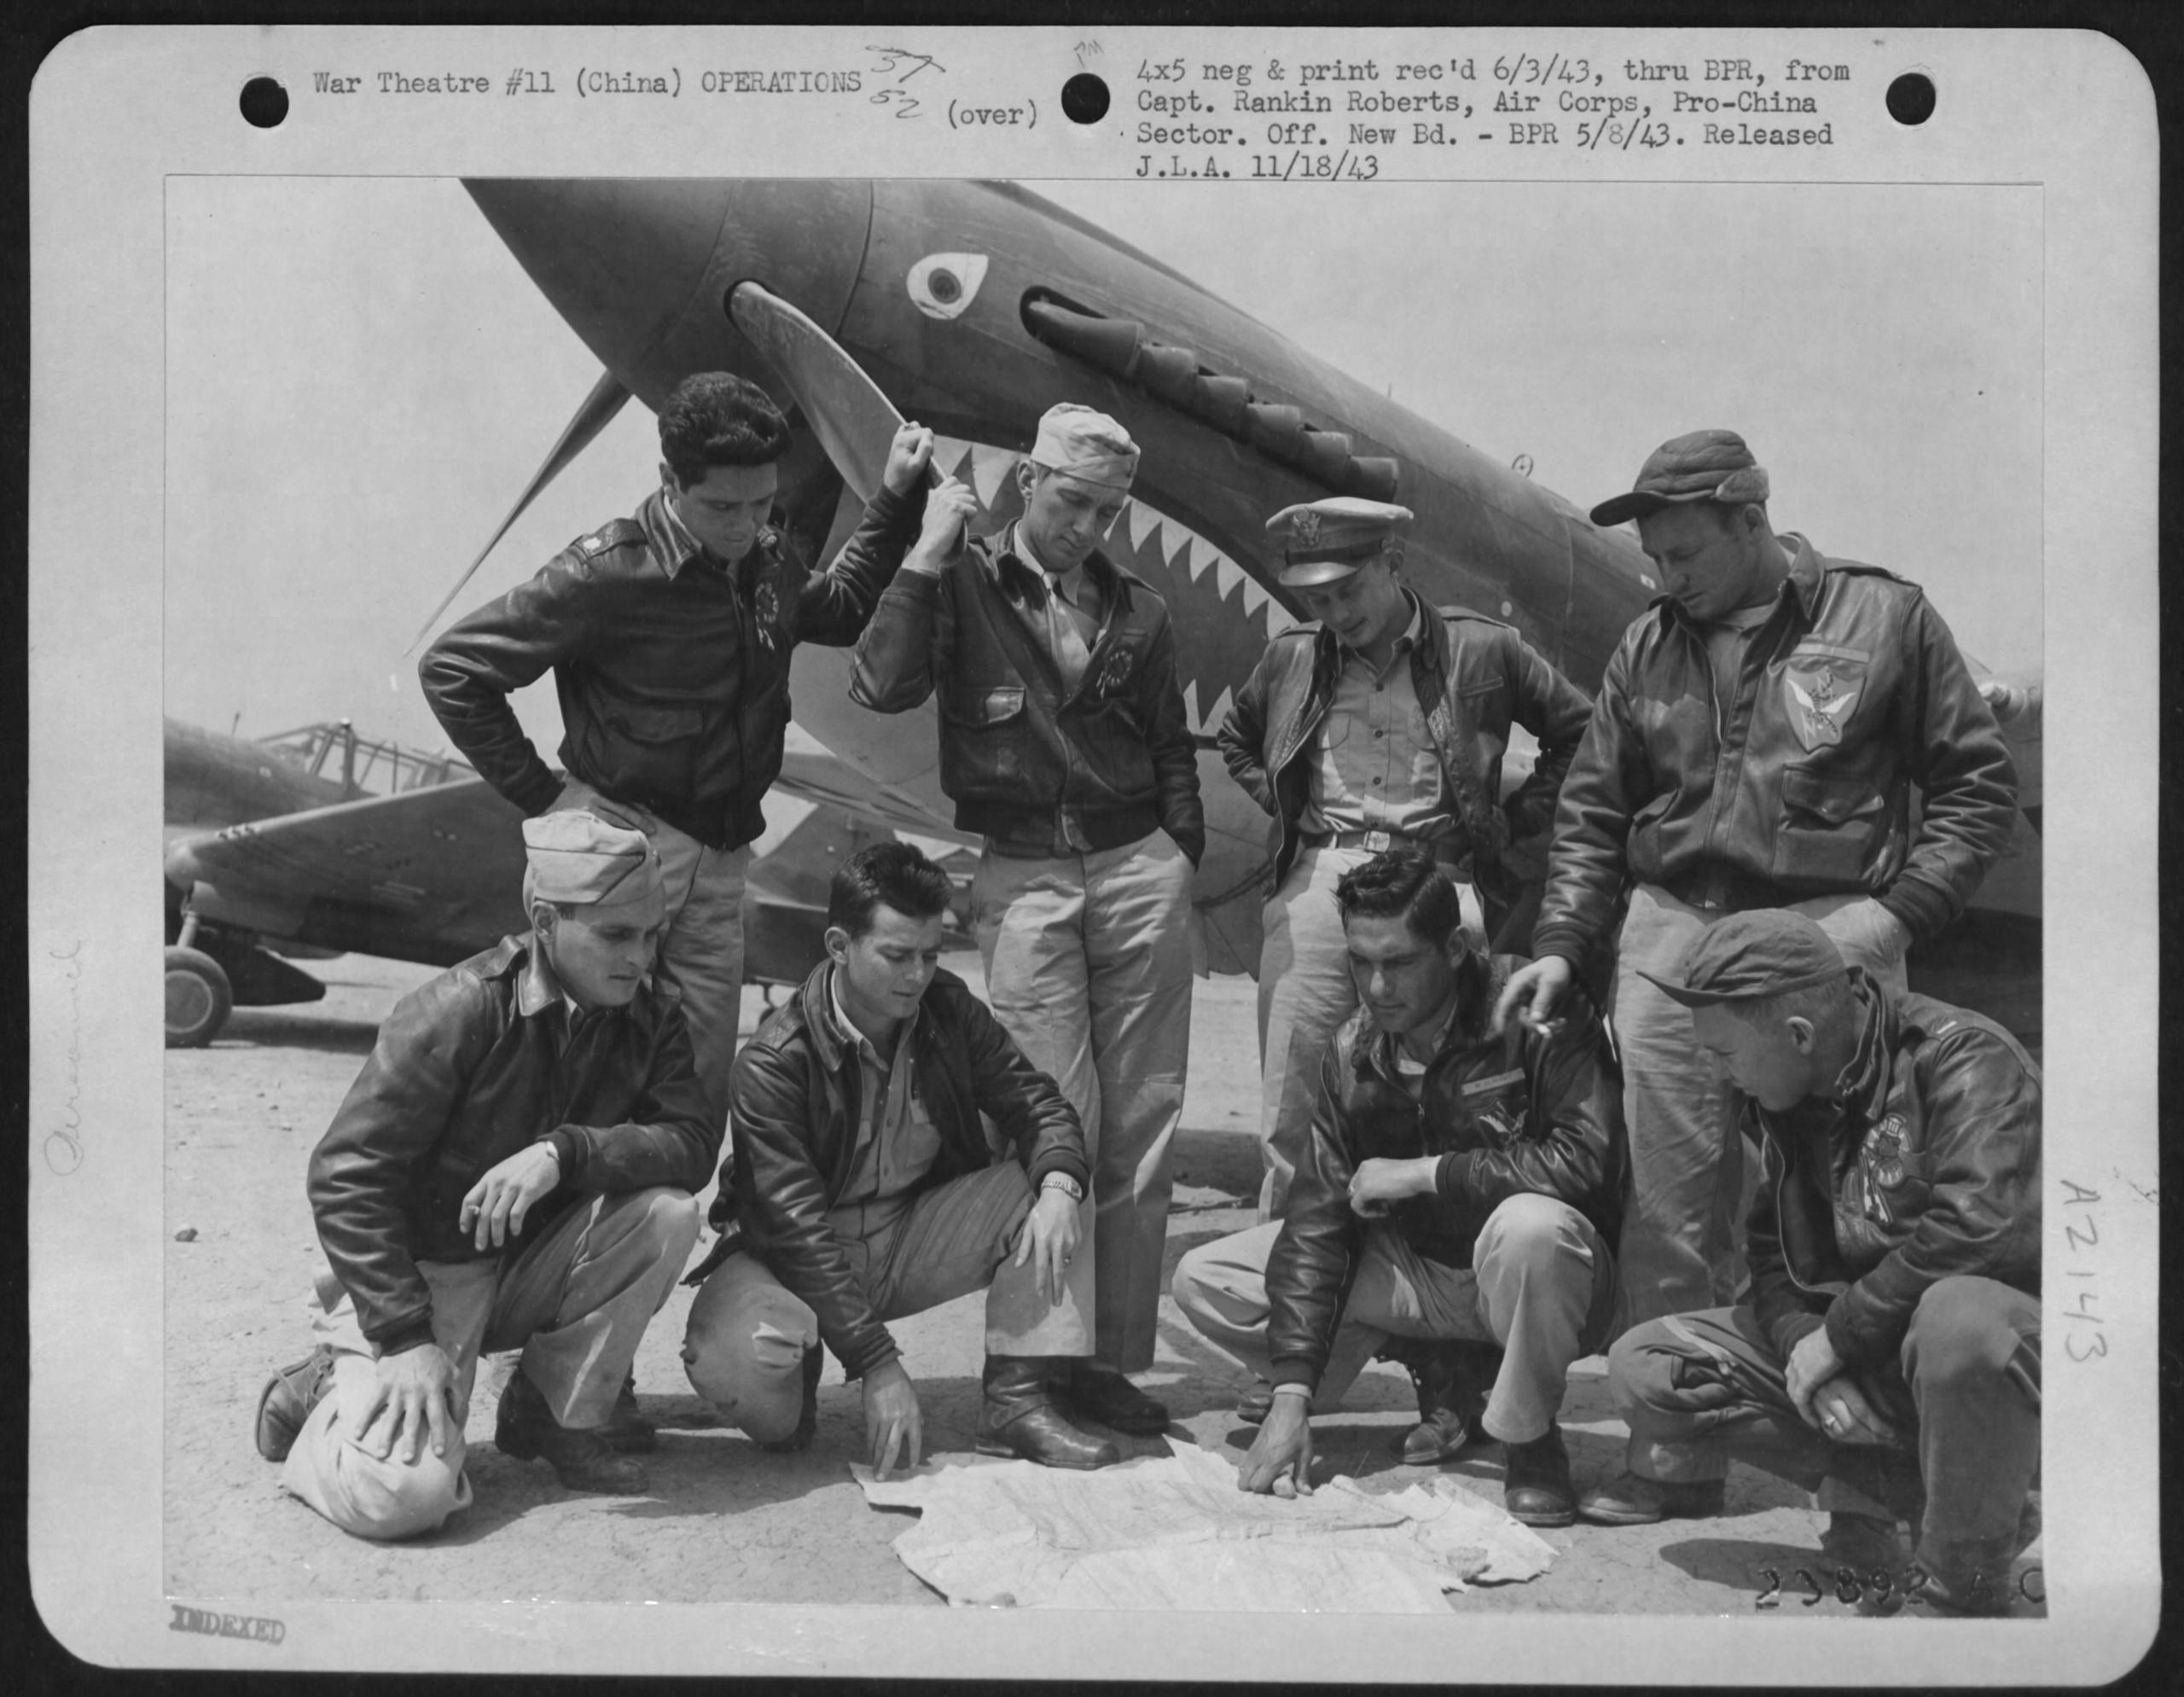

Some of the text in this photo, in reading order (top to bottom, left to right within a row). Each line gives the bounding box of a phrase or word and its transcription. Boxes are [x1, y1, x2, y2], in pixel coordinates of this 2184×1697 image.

[313, 67, 862, 98] War Theatre #11 (China) OPERATIONS
[1136, 53, 1850, 87] 4x5 neg & print rec'd 6/3/43, thru BPR, from
[949, 98, 1037, 130] (over)
[1137, 90, 1818, 119] Capt. Rankin Roberts, Air Corps, Pro-China
[1136, 122, 1247, 146] Sector.
[1267, 123, 1327, 146] Off.
[1348, 123, 1397, 145] New
[1413, 123, 1457, 146] Bd.
[1508, 123, 1560, 145] BPR
[1577, 118, 1686, 151] 5/8/43.
[1704, 123, 1834, 146] Released
[1136, 149, 1380, 182] J.L.A. 11/18/43
[168, 1603, 287, 1646] INDEXED
